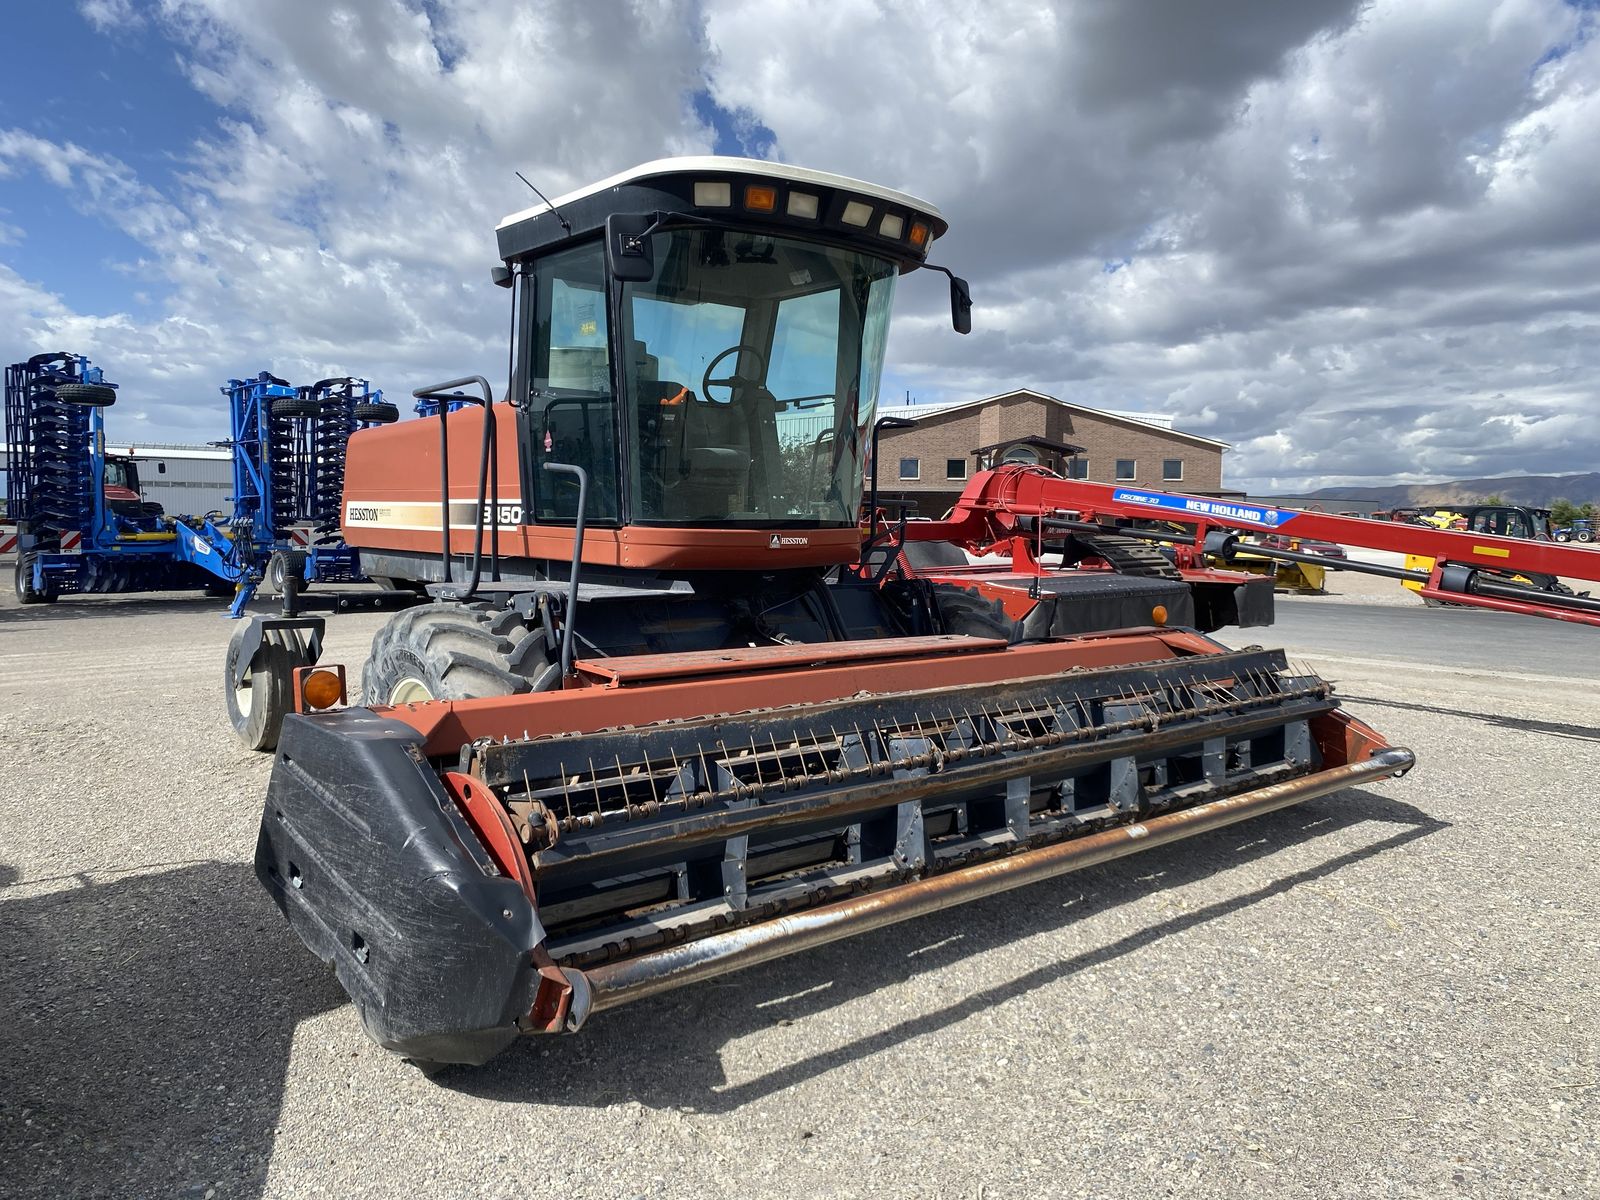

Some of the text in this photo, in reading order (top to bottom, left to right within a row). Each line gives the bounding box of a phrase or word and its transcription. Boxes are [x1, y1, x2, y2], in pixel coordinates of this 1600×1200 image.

[349, 507, 379, 521] HESSTON
[1186, 499, 1261, 521] NEW HOLLAND
[781, 537, 808, 545] HESSTON
